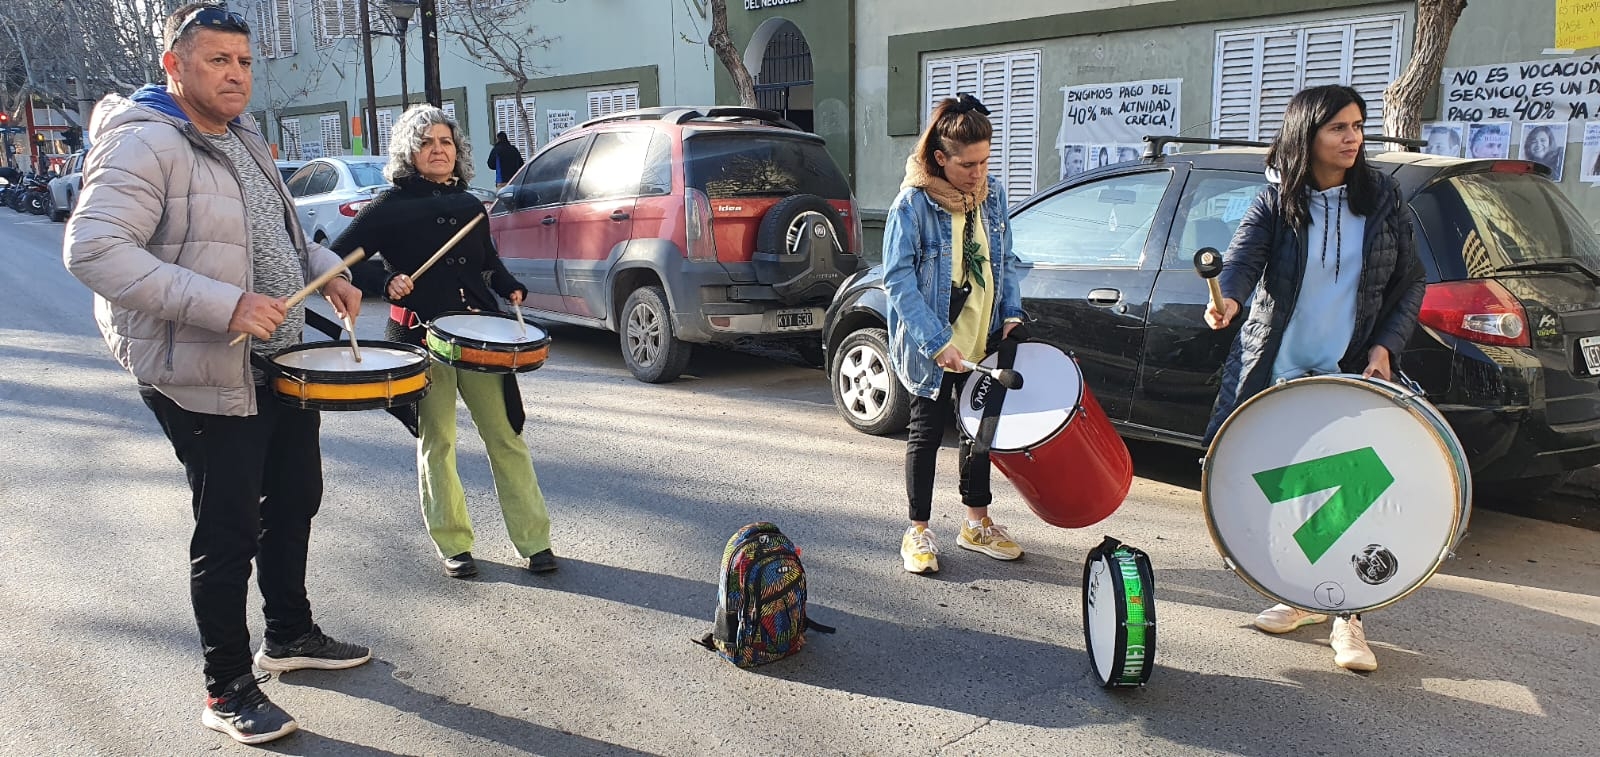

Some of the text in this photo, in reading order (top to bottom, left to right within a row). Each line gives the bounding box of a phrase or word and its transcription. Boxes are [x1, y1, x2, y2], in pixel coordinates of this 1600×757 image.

[1451, 70, 1478, 86] NO
[1485, 67, 1509, 84] ES
[1067, 83, 1172, 102] EXIGIMOS PAGO DEL
[1560, 80, 1582, 96] UN
[1067, 99, 1171, 125] 40% POR ACTIVIDAD
[1448, 106, 1483, 122] PAGO
[1487, 107, 1510, 118] DEL
[1513, 99, 1556, 121] 40%
[1568, 101, 1588, 121] YA
[777, 313, 812, 328] KYY 630
